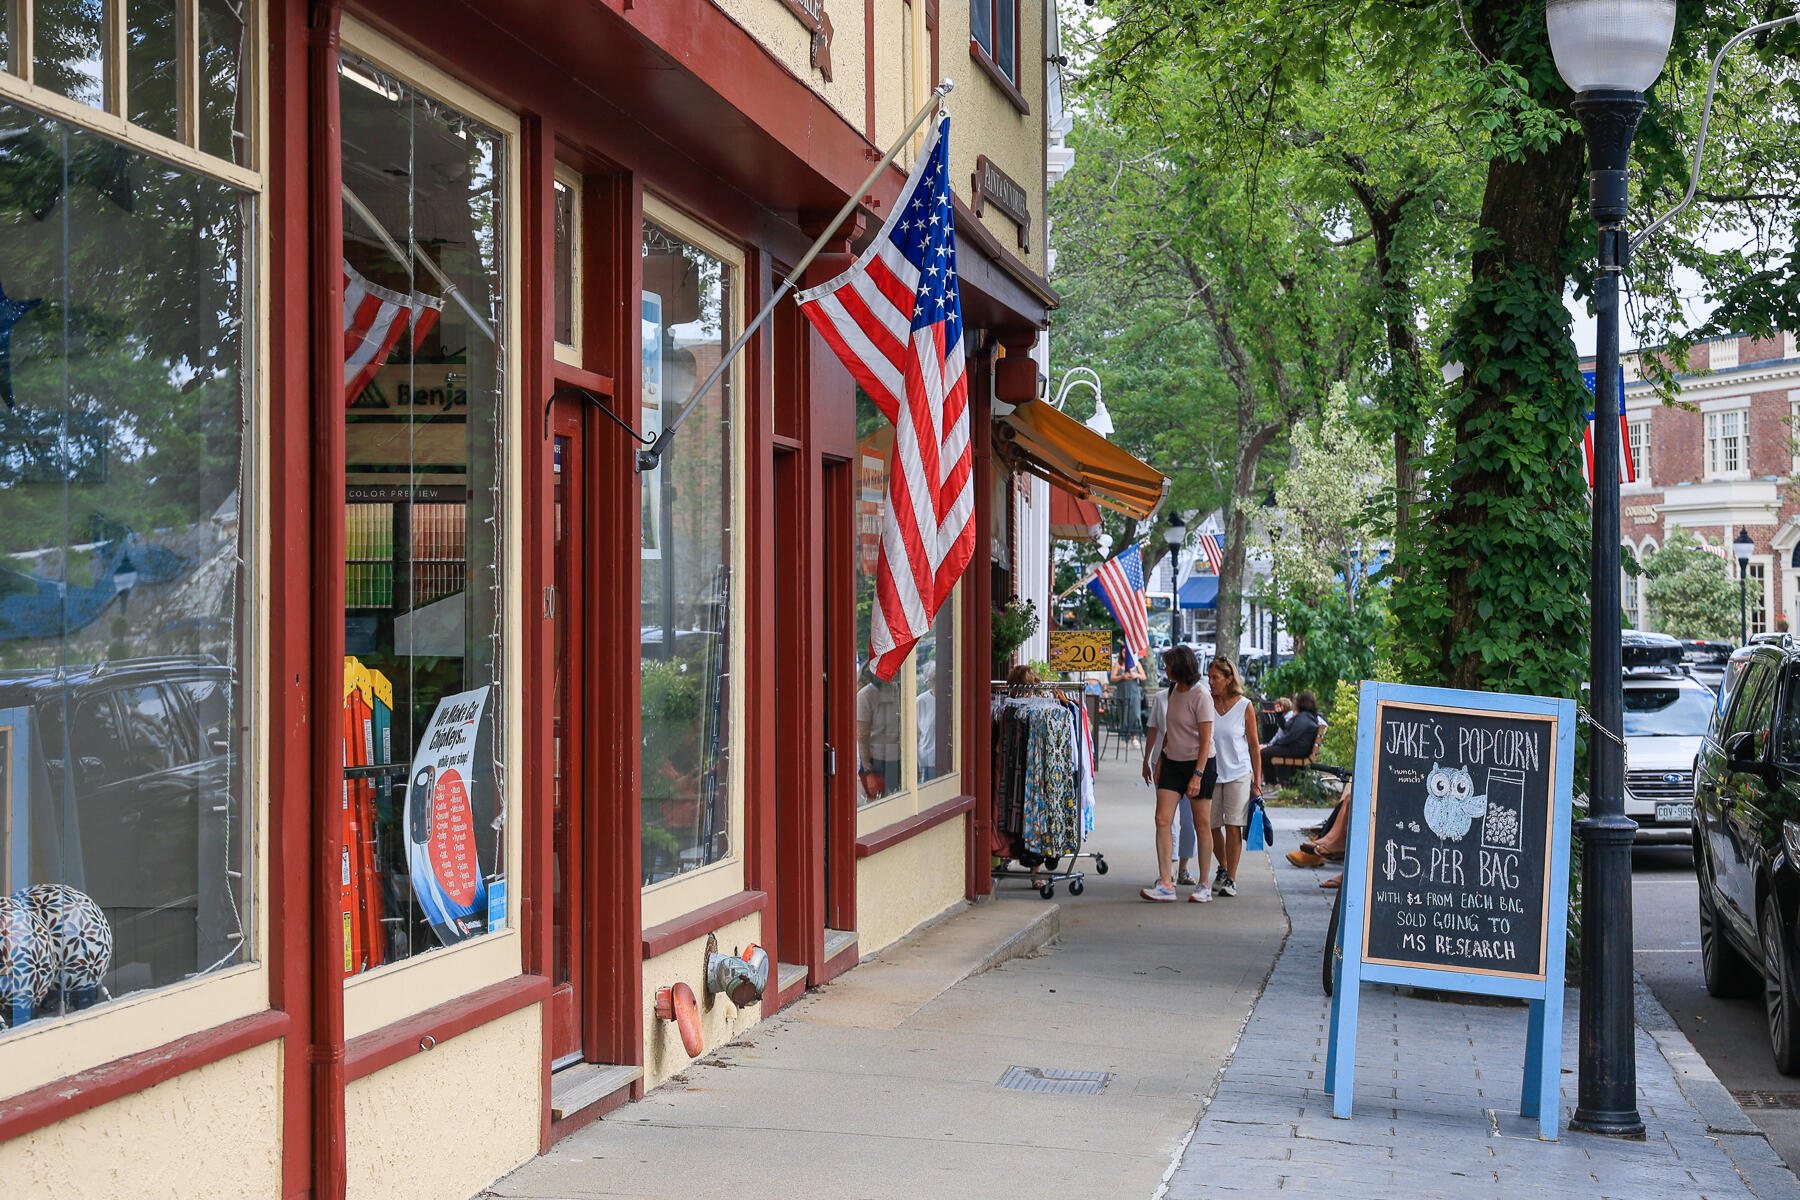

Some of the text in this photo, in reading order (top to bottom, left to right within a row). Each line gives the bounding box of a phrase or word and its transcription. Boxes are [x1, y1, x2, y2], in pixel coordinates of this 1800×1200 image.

[398, 383, 466, 411] Benja
[349, 490, 439, 498] COLOR PREIEW
[1064, 645, 1096, 663] $20
[1386, 718, 1539, 772] JAKE'S POPCORN
[1382, 839, 1520, 890] $5 PER BAG
[1376, 891, 1524, 914] WITH $1 FROM EACH BAG
[1396, 911, 1511, 934] SOLD GOING TO
[1402, 933, 1516, 960] MS RESEARCH
